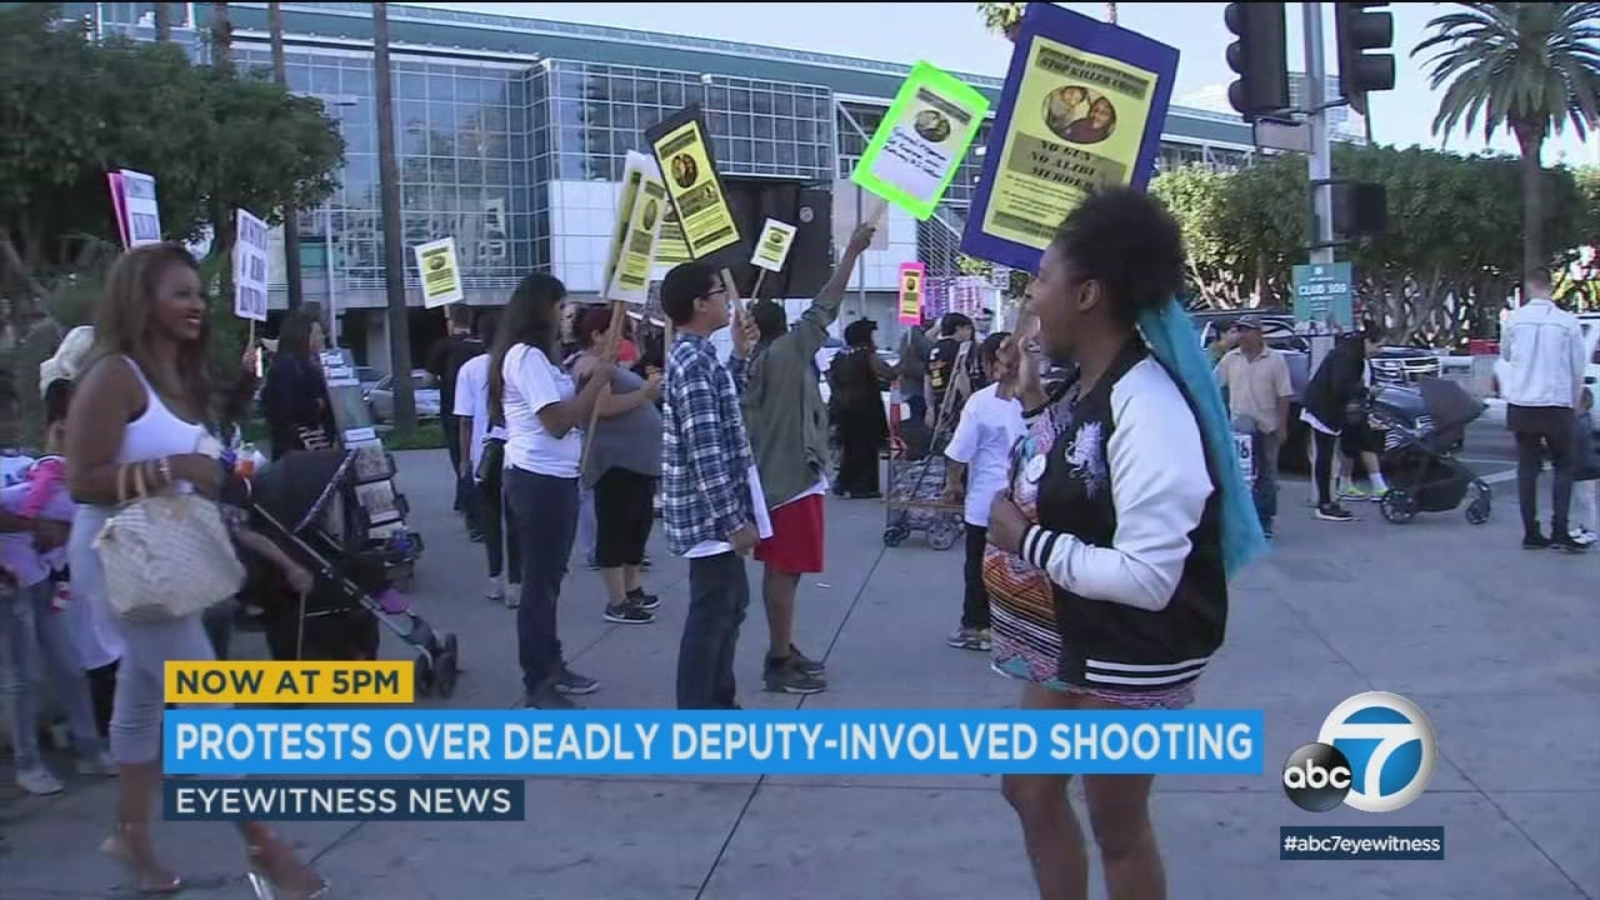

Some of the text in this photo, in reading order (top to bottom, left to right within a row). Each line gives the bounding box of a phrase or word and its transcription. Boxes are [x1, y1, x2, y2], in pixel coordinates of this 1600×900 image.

[1041, 140, 1092, 161] NO GUN
[1031, 151, 1096, 176] NO ALIBI
[1032, 166, 1095, 191] MURDER
